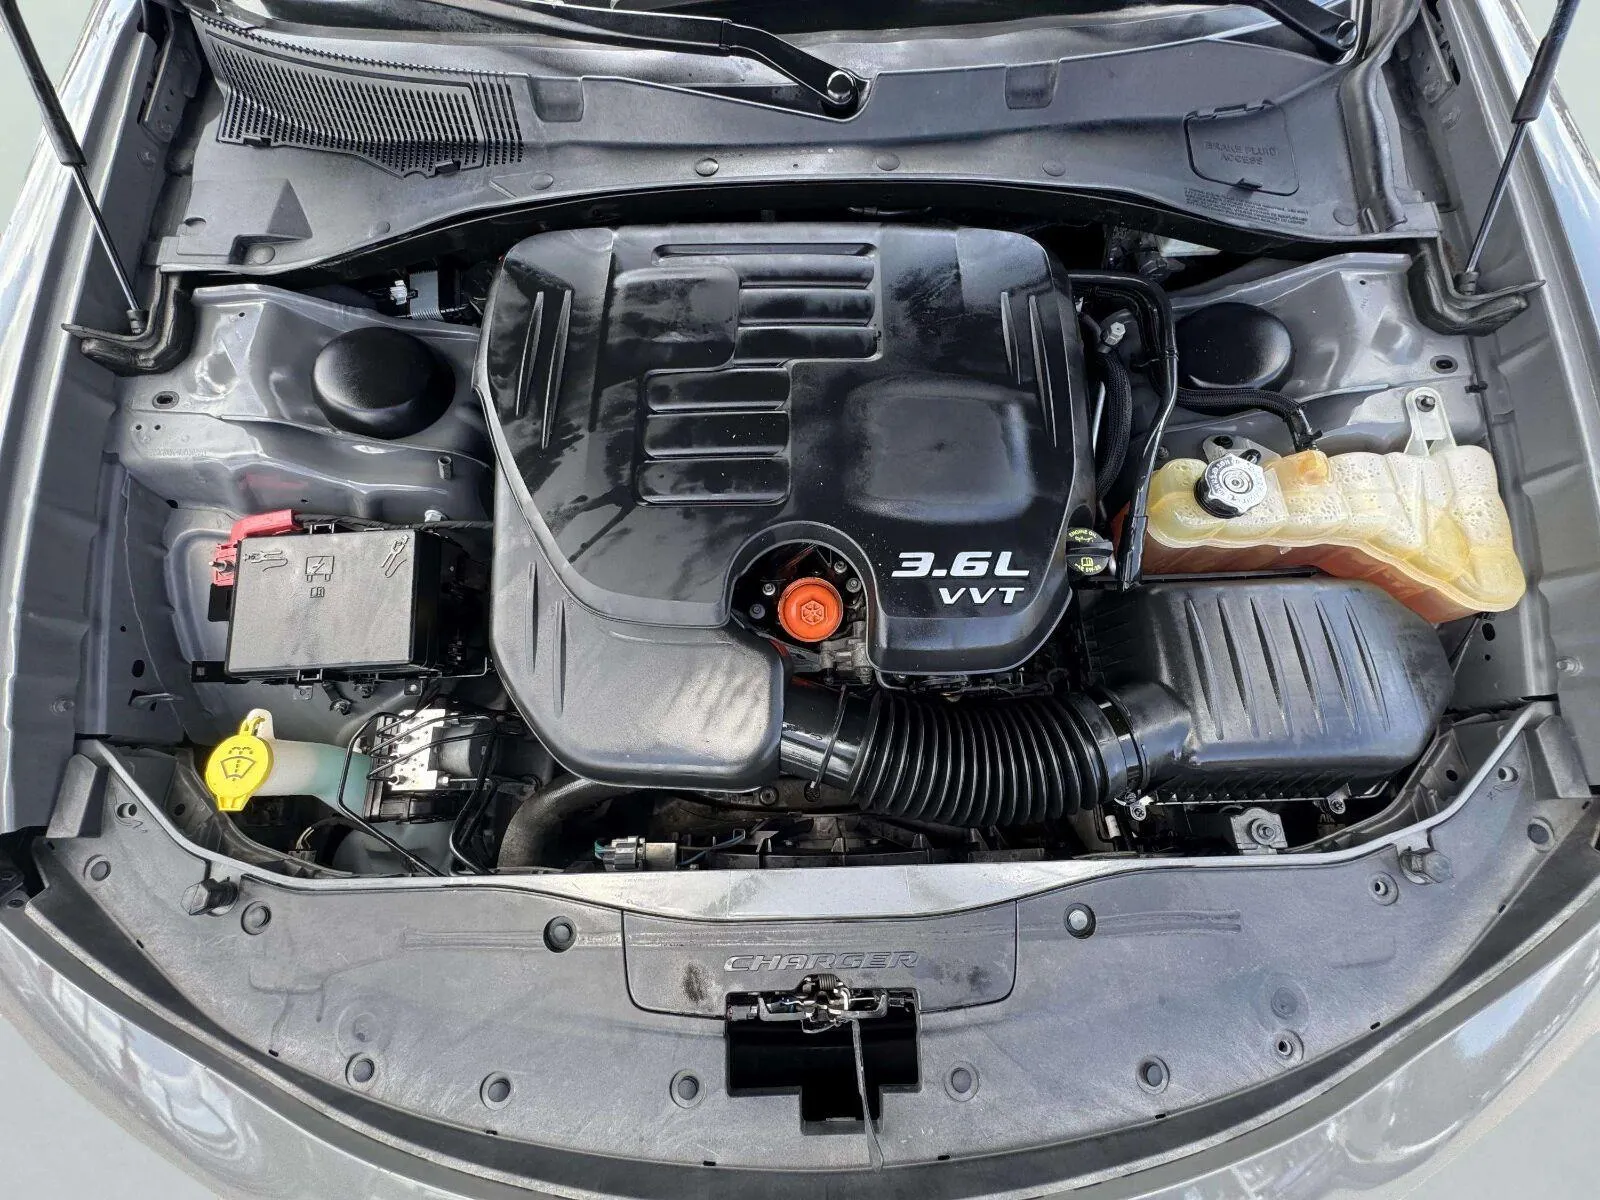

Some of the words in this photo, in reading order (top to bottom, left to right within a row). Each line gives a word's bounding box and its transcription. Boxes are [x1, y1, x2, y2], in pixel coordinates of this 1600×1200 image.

[1204, 140, 1242, 153] BRAKE
[1220, 152, 1264, 165] ACCESS
[1088, 530, 1098, 539] OIL
[892, 551, 1030, 577] 3.6L
[939, 587, 1024, 604] VVT
[724, 951, 918, 972] CHARGER
